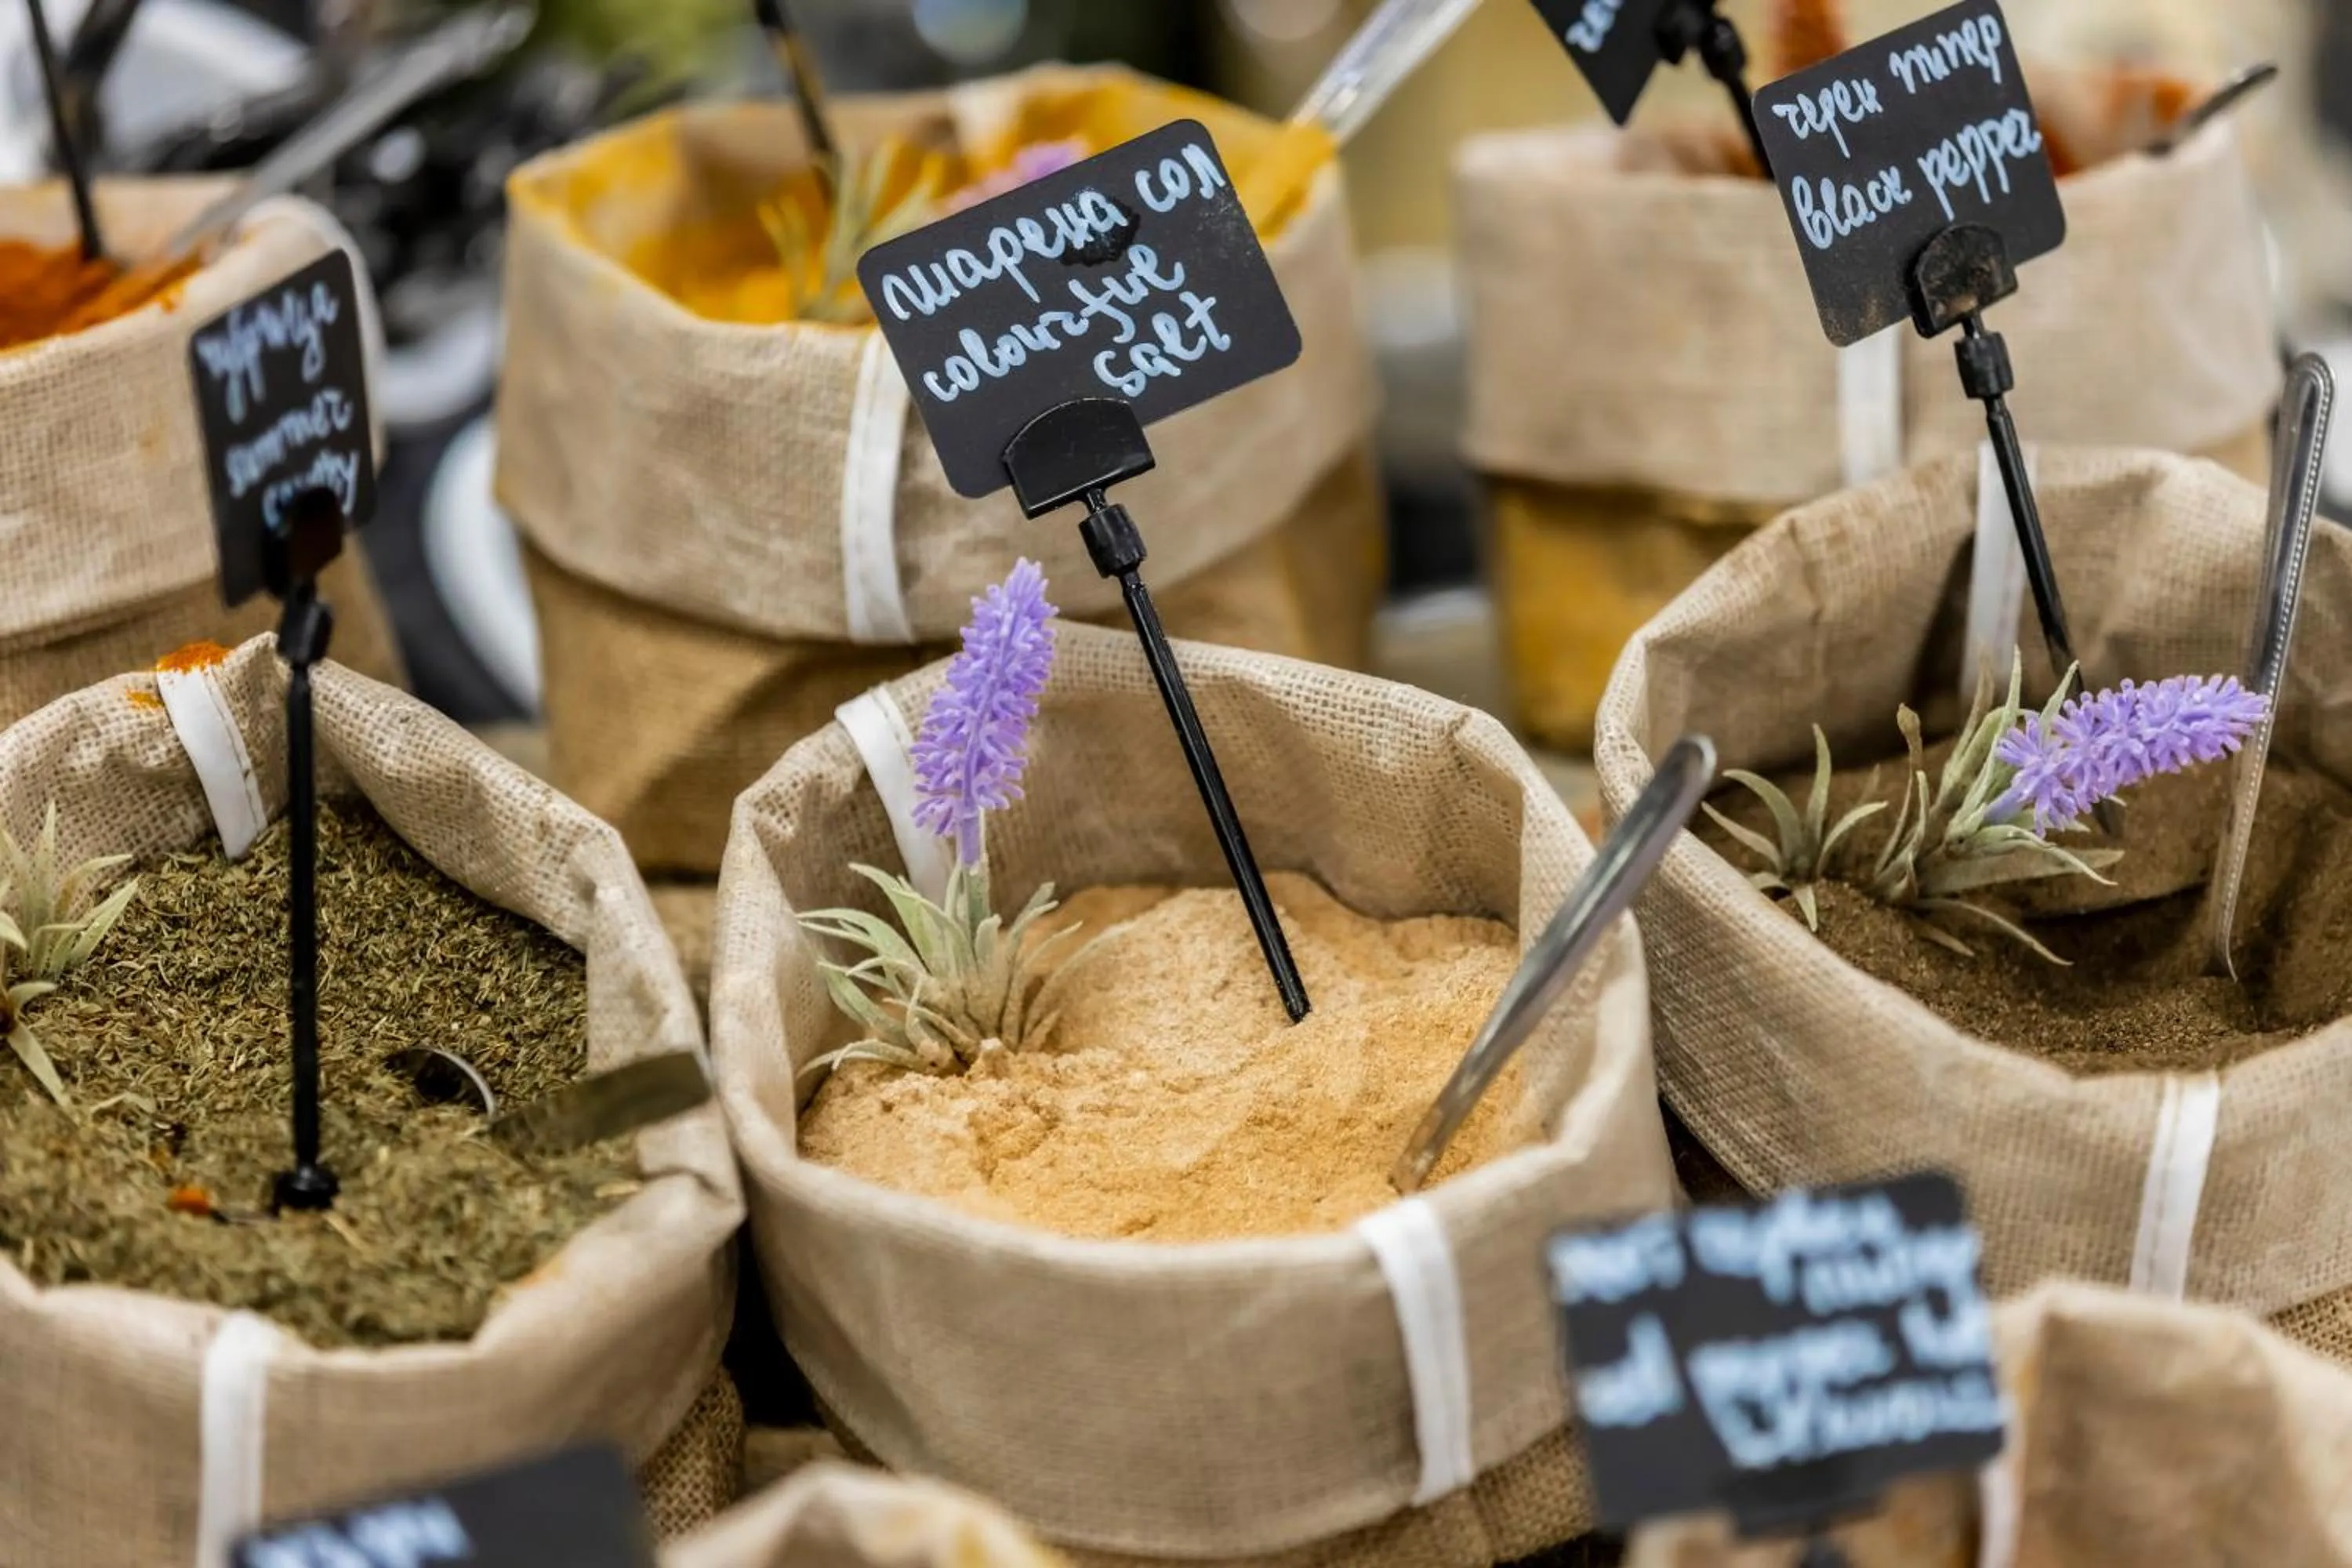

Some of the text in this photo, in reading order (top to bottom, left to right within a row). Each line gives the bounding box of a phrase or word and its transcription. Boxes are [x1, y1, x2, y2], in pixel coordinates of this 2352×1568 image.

[882, 143, 1226, 320] шарена сол
[1791, 107, 2042, 249] black pepper
[1093, 291, 1232, 397] salt
